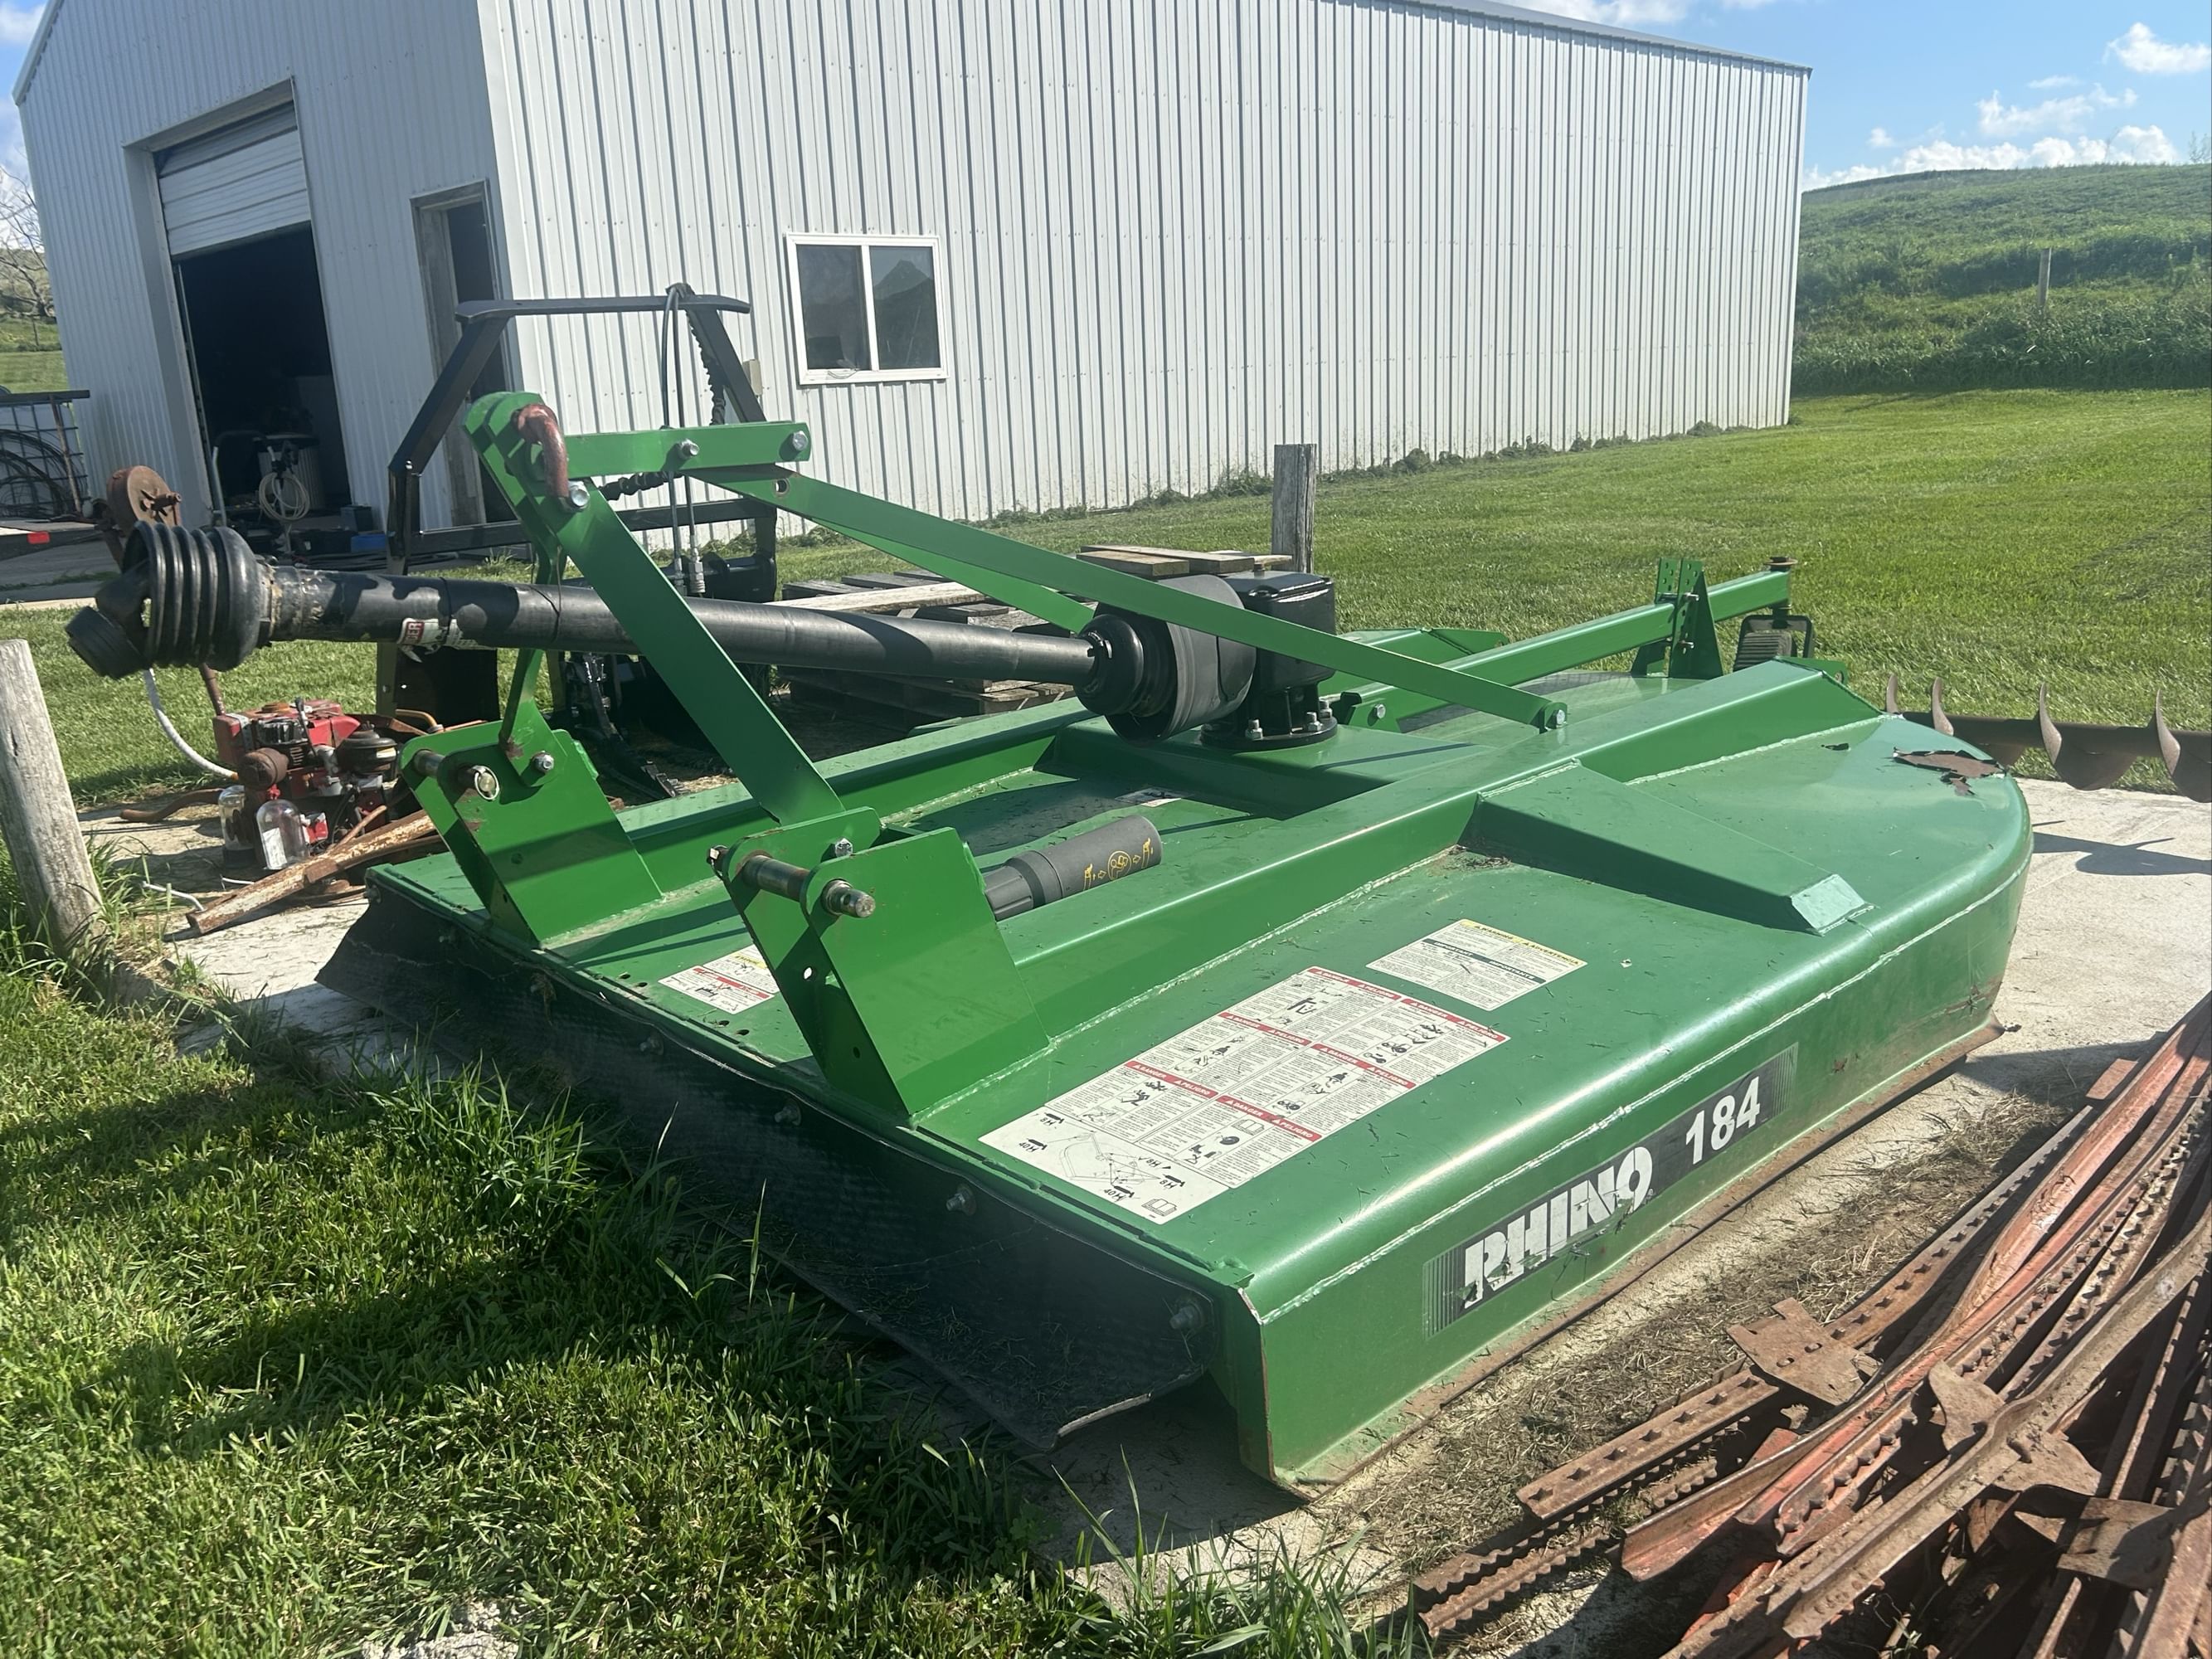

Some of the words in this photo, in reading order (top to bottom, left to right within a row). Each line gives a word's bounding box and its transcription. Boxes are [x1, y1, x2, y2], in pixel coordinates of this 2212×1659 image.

[1328, 1049, 1359, 1064] DANGER
[1375, 1068, 1409, 1086] PELIGRO
[1179, 1082, 1211, 1097] PELIGRO
[1232, 1101, 1264, 1118] DANGER
[1277, 1120, 1314, 1139] PELIGRO
[1464, 1146, 1653, 1309] RHINO
[1685, 1076, 1761, 1165] 184
